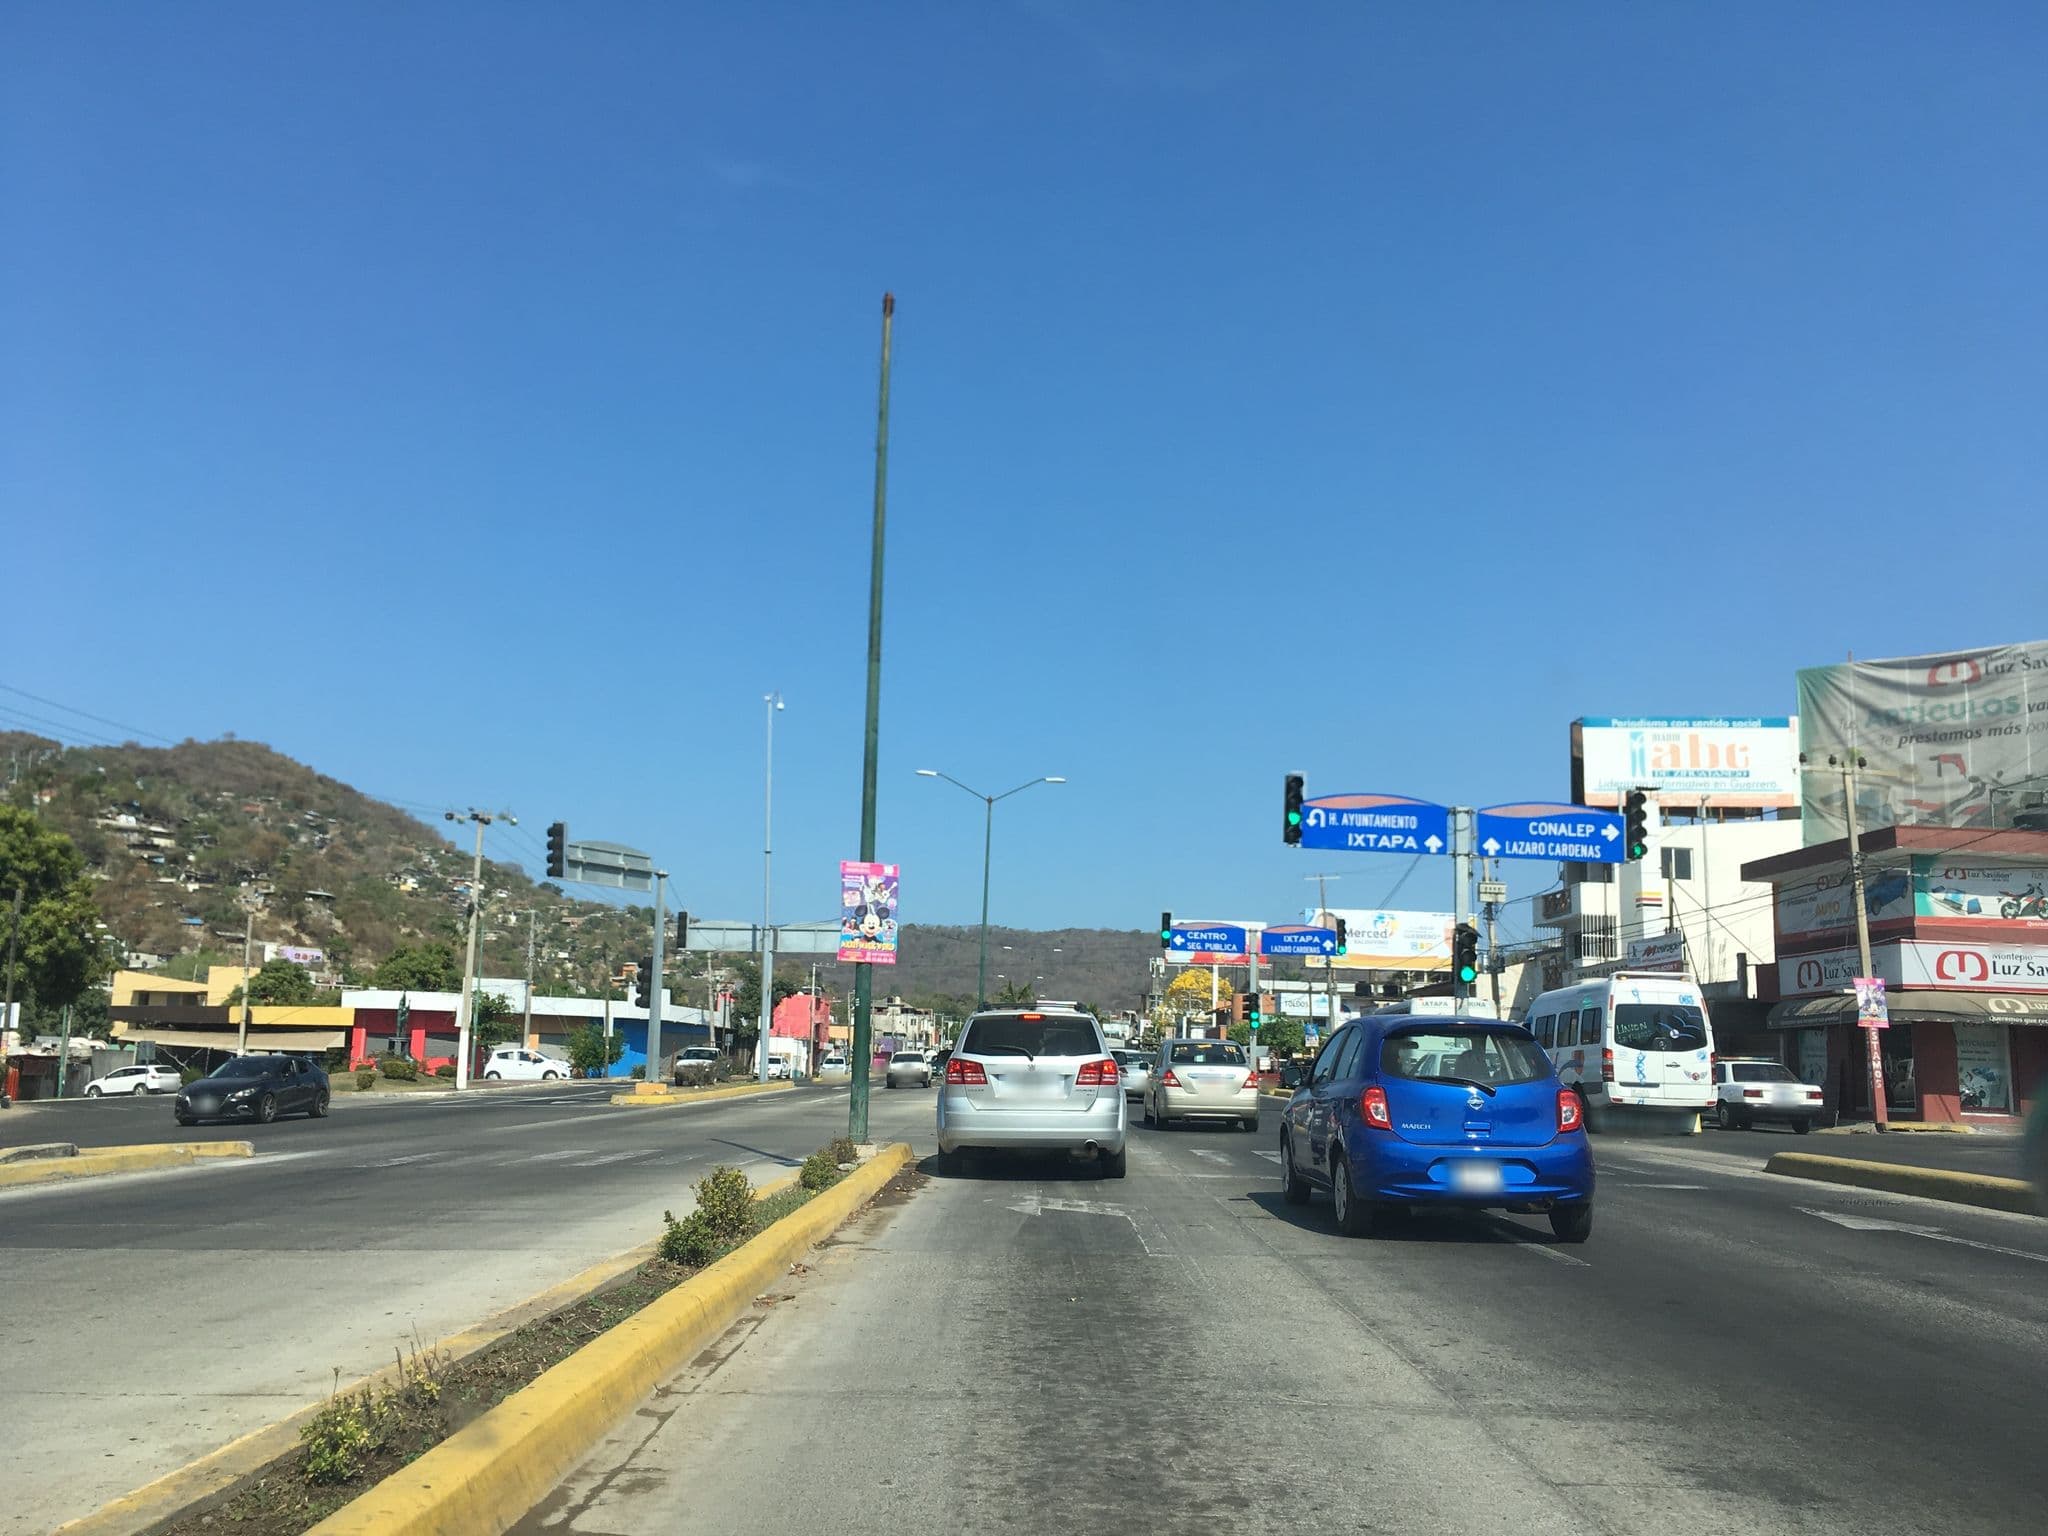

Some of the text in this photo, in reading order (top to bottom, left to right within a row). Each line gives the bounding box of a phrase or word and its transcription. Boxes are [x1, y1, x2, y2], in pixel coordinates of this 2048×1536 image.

[1984, 661, 2015, 676] Luz
[1670, 720, 1690, 728] con
[1897, 729, 1982, 749] prestamos
[1987, 721, 2022, 737] más
[1341, 812, 1418, 830] AYUNTAMIENTO
[1528, 821, 1596, 838] CONALEP
[1347, 833, 1418, 849] IXTAPA
[1505, 840, 1602, 859] LAZARO CARDENAS
[1187, 931, 1228, 941] CENTRO
[1283, 935, 1321, 943] IXTAPA
[1204, 942, 1238, 952] PUBLICA
[1824, 966, 1839, 980] Luz
[1992, 961, 2021, 975] Luz
[1870, 1027, 1882, 1089] STAMOS
[1401, 1122, 1432, 1130] MARCH
